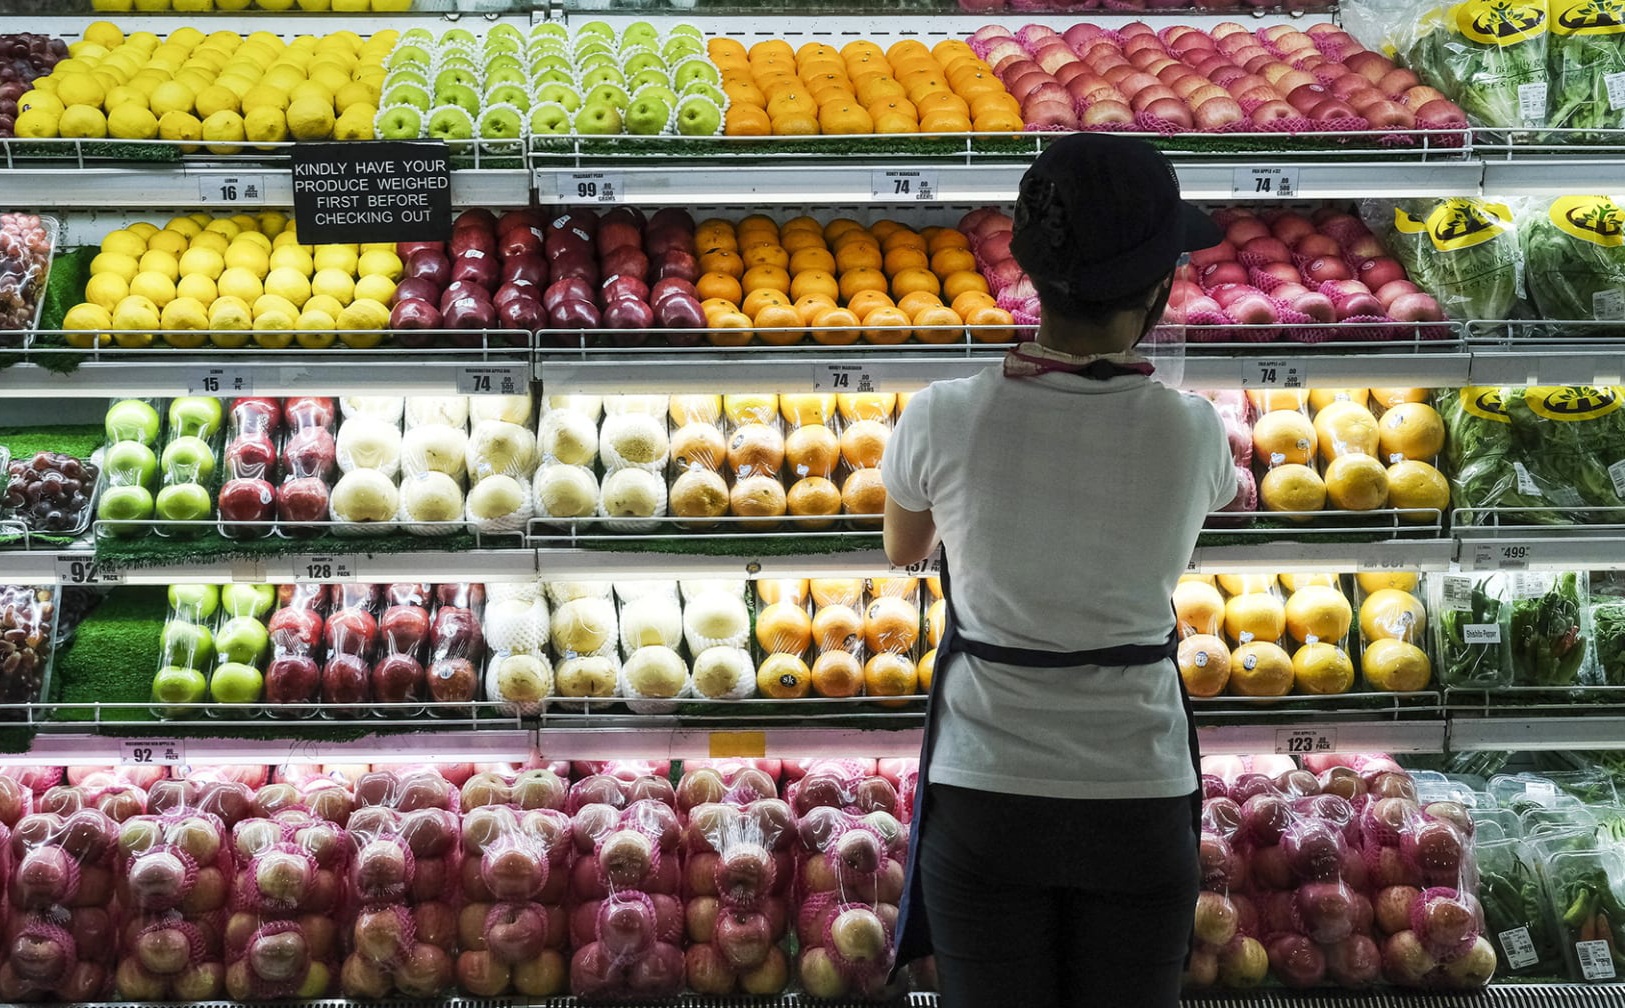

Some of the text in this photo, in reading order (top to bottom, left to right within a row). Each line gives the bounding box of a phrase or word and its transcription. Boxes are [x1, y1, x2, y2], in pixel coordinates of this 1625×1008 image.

[294, 159, 446, 176] KINDLY HAVE YOUR
[295, 176, 448, 193] PRODUCE WEIGHED
[577, 182, 597, 198] 99
[893, 179, 910, 194] 74
[1255, 177, 1271, 192] 74
[219, 185, 237, 201] 16
[316, 193, 428, 209] FIRST BEFORE
[314, 210, 432, 225] CHECKING OUT
[472, 375, 491, 391] 74
[832, 373, 849, 388] 74
[1260, 368, 1277, 383] 74
[202, 377, 219, 391] 15
[1504, 546, 1526, 559] 499
[71, 561, 99, 583] 92
[306, 564, 332, 579] 128
[1287, 737, 1313, 752] 123
[133, 748, 153, 762] 92
